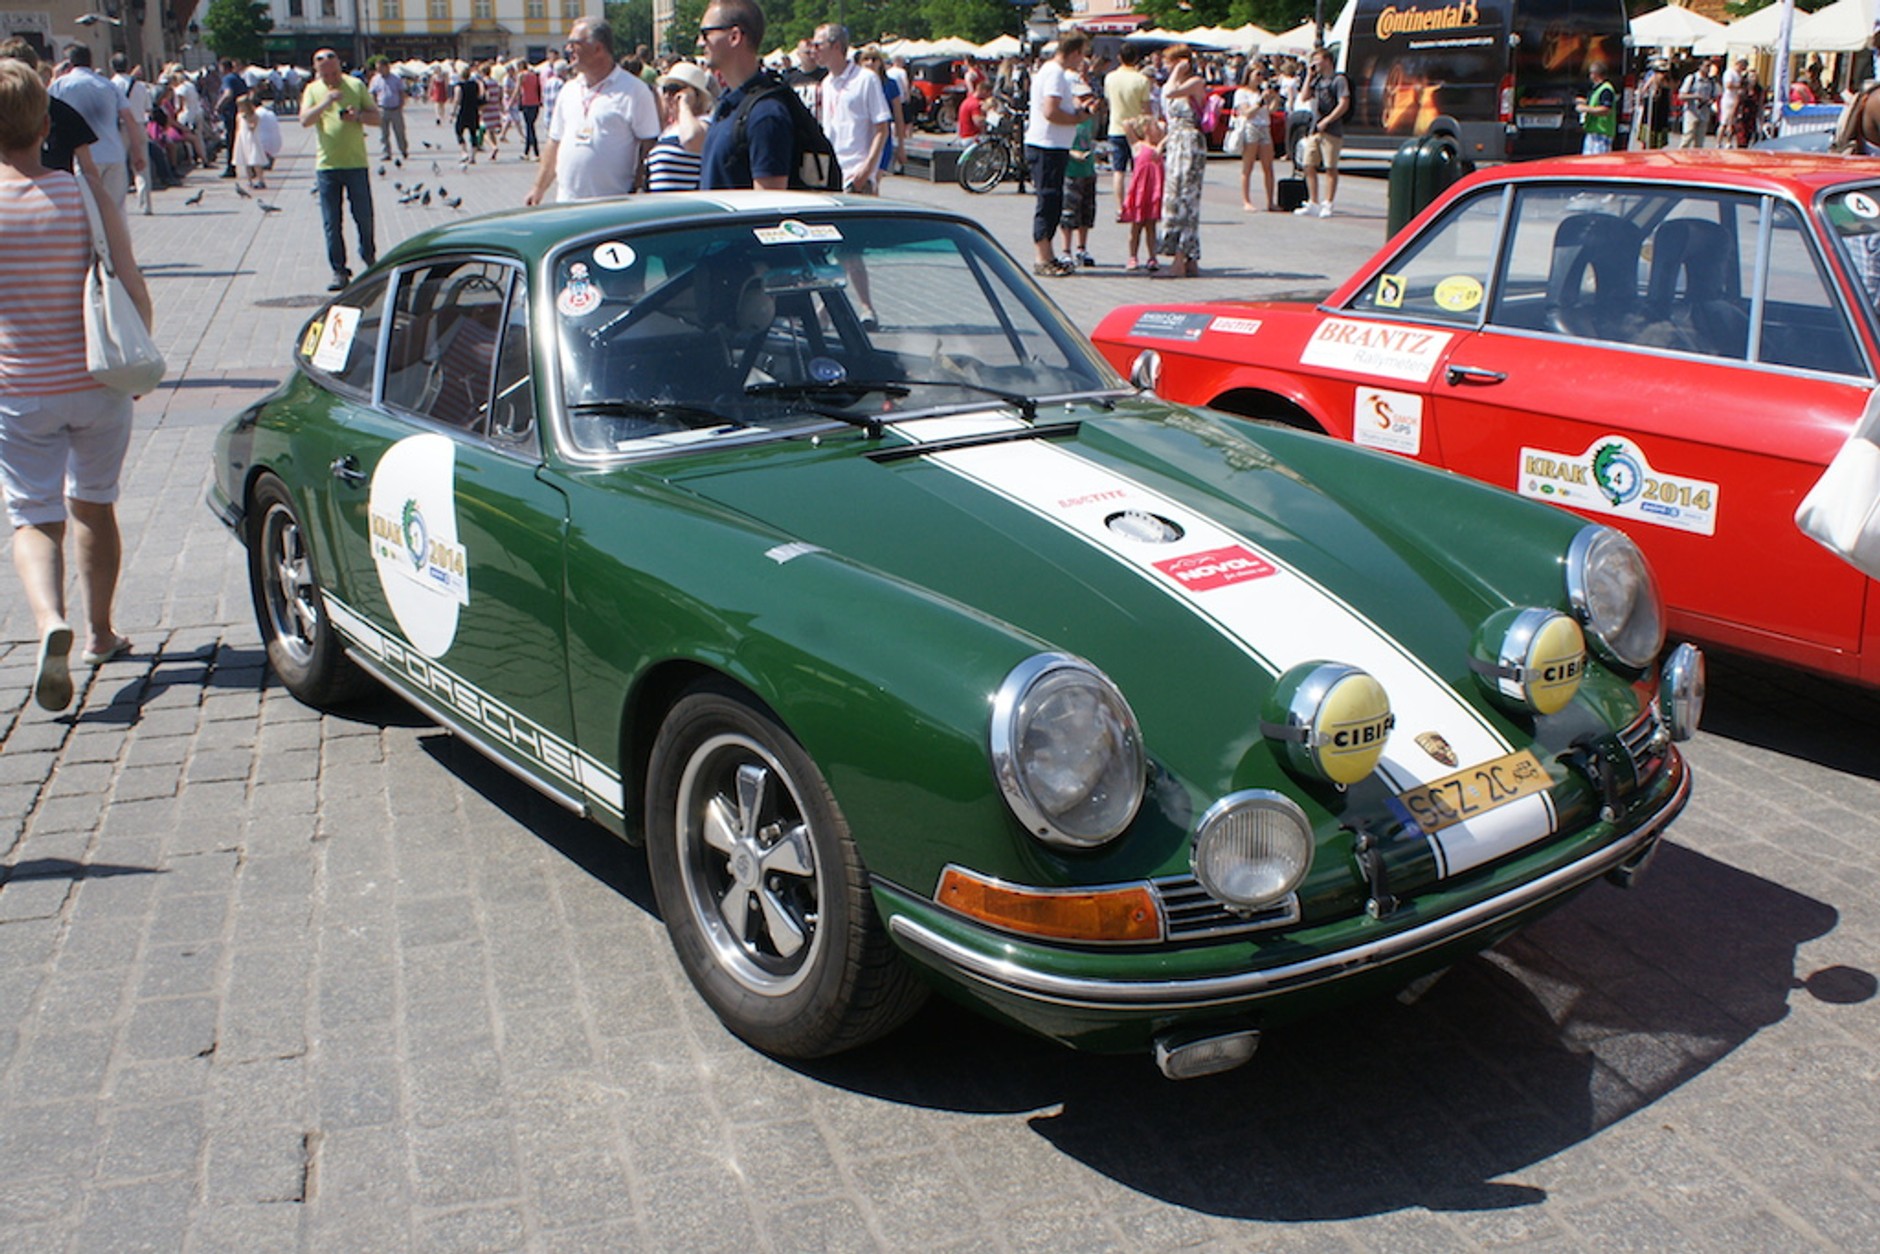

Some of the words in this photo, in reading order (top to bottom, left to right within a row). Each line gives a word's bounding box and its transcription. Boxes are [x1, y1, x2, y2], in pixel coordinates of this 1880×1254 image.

[1376, 0, 1467, 40] Continental
[1856, 197, 1871, 213] 4
[605, 247, 620, 264] 1
[1316, 321, 1434, 356] BRANTZ
[1353, 349, 1430, 373] Rallymeters
[1058, 488, 1128, 509] LOCTITE
[1525, 455, 1589, 487] KRAK
[1612, 471, 1623, 486] 4
[1641, 477, 1712, 512] 2014
[372, 512, 402, 548] KRAK
[428, 538, 465, 577] 2014
[1175, 556, 1262, 583] NOVOL
[1544, 657, 1589, 684] CIBI
[383, 636, 575, 781] PORSCHE
[1408, 780, 1480, 828] SCZ
[1474, 765, 1519, 808] 2C
